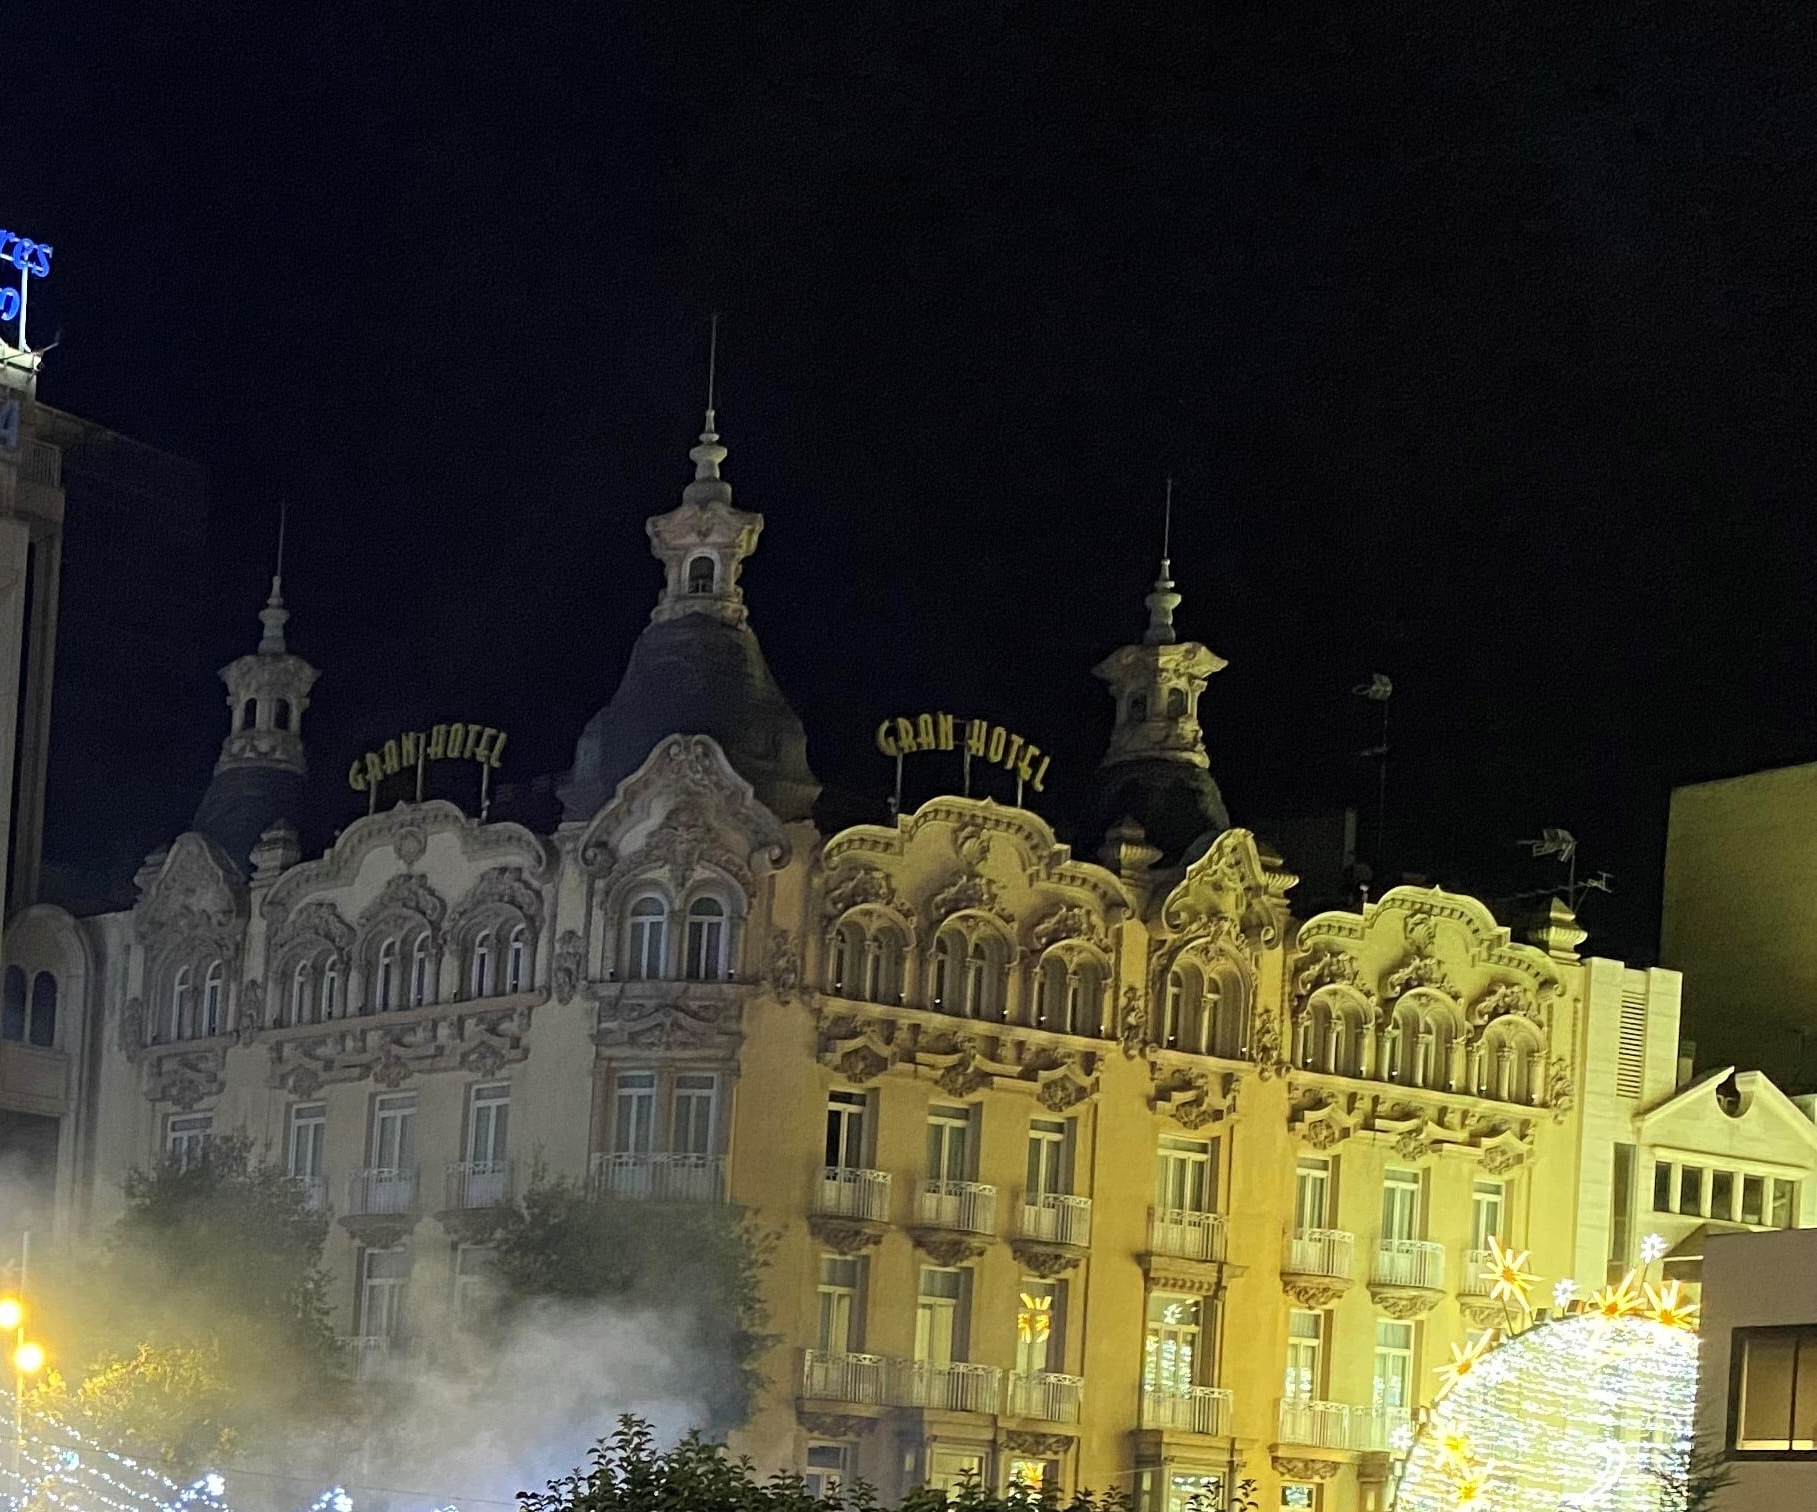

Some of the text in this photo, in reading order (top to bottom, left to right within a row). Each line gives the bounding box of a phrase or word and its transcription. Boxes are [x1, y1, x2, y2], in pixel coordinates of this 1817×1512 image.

[349, 722, 508, 791] GRAN HOTEL
[876, 711, 1050, 792] GRAN HOTEL
